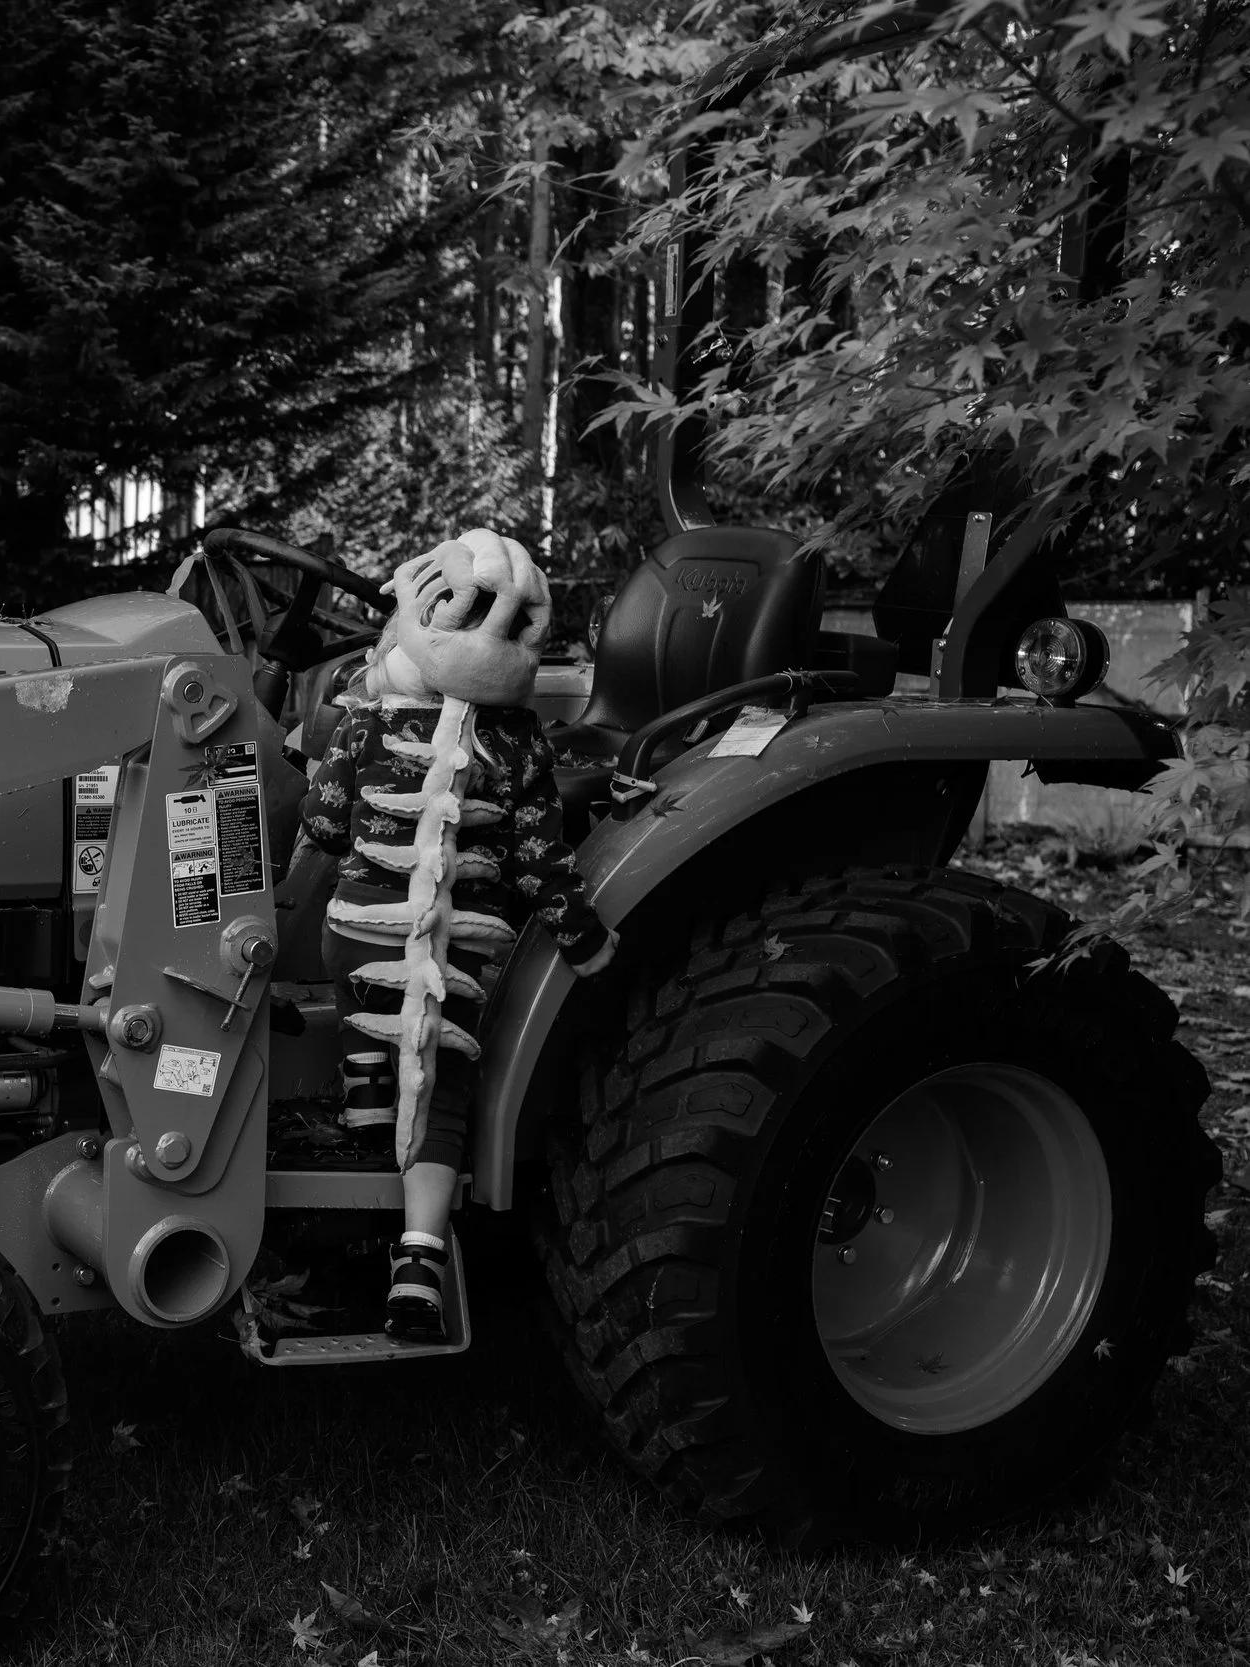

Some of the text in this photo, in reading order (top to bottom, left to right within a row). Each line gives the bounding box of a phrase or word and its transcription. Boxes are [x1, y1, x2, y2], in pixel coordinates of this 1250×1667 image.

[676, 567, 747, 595] Kubota
[224, 787, 257, 797] WARNING
[172, 817, 210, 828] LUBRICATE
[180, 849, 213, 860] WARNING
